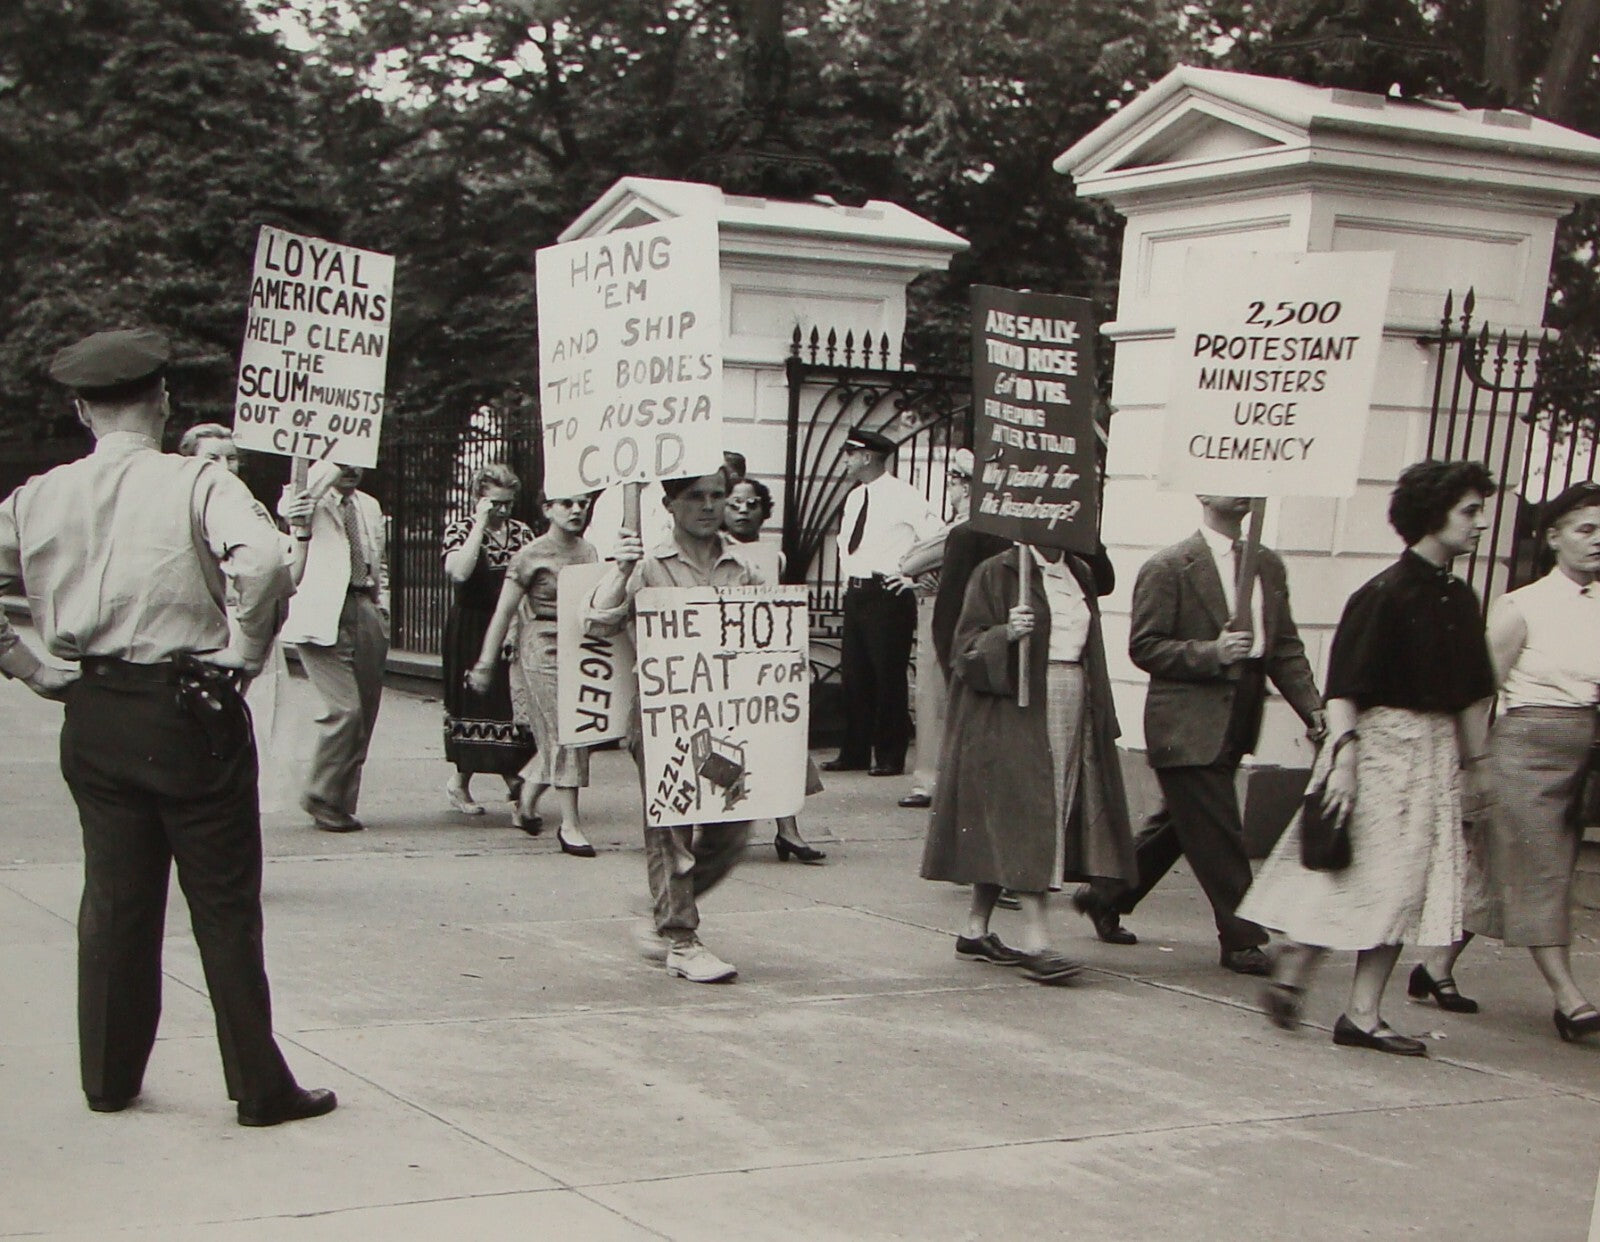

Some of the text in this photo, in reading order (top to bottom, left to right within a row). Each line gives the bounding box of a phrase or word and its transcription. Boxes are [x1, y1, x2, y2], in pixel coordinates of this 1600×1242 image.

[265, 235, 369, 289] LOYAL
[571, 236, 671, 288] HANG
[250, 276, 386, 322] AMERICANS
[597, 279, 647, 309] 'EM
[985, 309, 1016, 335] AXIS
[1246, 300, 1342, 329] 2,500
[247, 317, 384, 357] HELP CLEAN
[552, 311, 696, 363] AND SHIP
[1193, 333, 1361, 362] PROTESTANT
[282, 350, 325, 373] THE
[547, 354, 713, 404] THE BODIES
[1027, 347, 1078, 377] ROSE
[1198, 367, 1328, 393] MINISTERS
[239, 402, 372, 438] OUT OF OUR
[546, 395, 711, 447] TO RUSSIA
[1234, 402, 1298, 427] URGE
[273, 428, 339, 460] CITY
[578, 432, 688, 487] C.O.D.
[1189, 434, 1315, 461] CLEMENCY
[1007, 463, 1049, 489] Death
[1051, 463, 1081, 490] for
[979, 492, 1000, 515] the
[637, 597, 807, 649] THE HOT
[575, 633, 614, 733] NGER
[640, 652, 804, 697] SEAT FOR
[643, 692, 801, 738] TRAITORS
[649, 736, 691, 824] SIZZLE
[670, 779, 697, 816] 'EM
